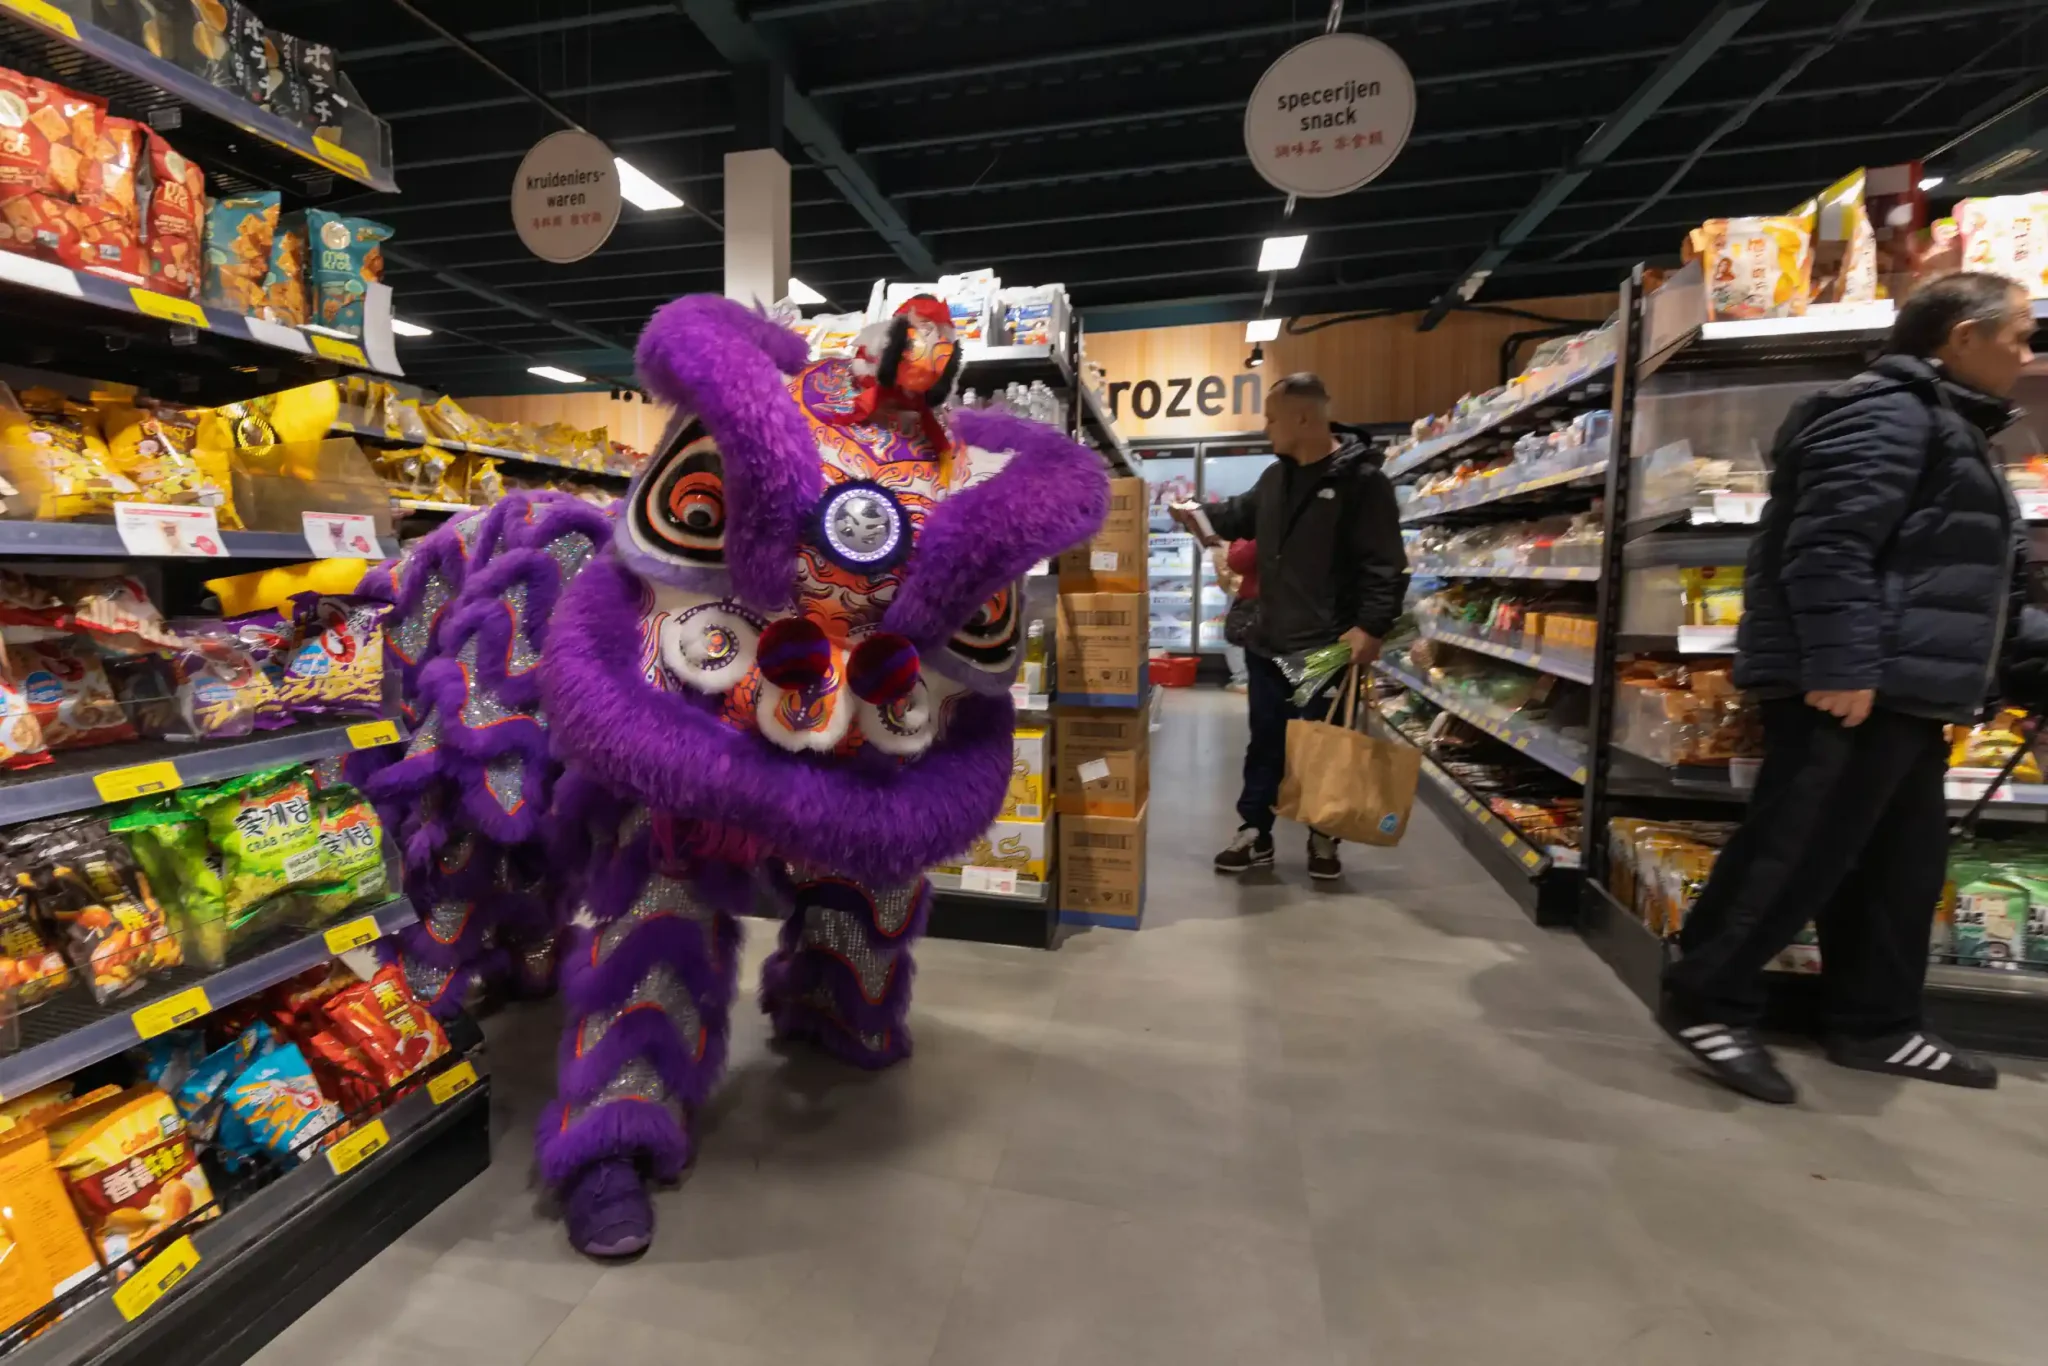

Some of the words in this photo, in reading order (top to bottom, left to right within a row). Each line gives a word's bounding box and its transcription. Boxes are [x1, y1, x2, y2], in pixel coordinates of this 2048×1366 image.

[304, 44, 333, 122] ポテチ
[1277, 80, 1381, 112] specerijen
[1300, 106, 1358, 131] snack
[526, 169, 607, 191] kruideniers-
[546, 192, 586, 208] waren
[1107, 373, 1262, 420] rozen
[235, 796, 310, 837] 꽃게랑
